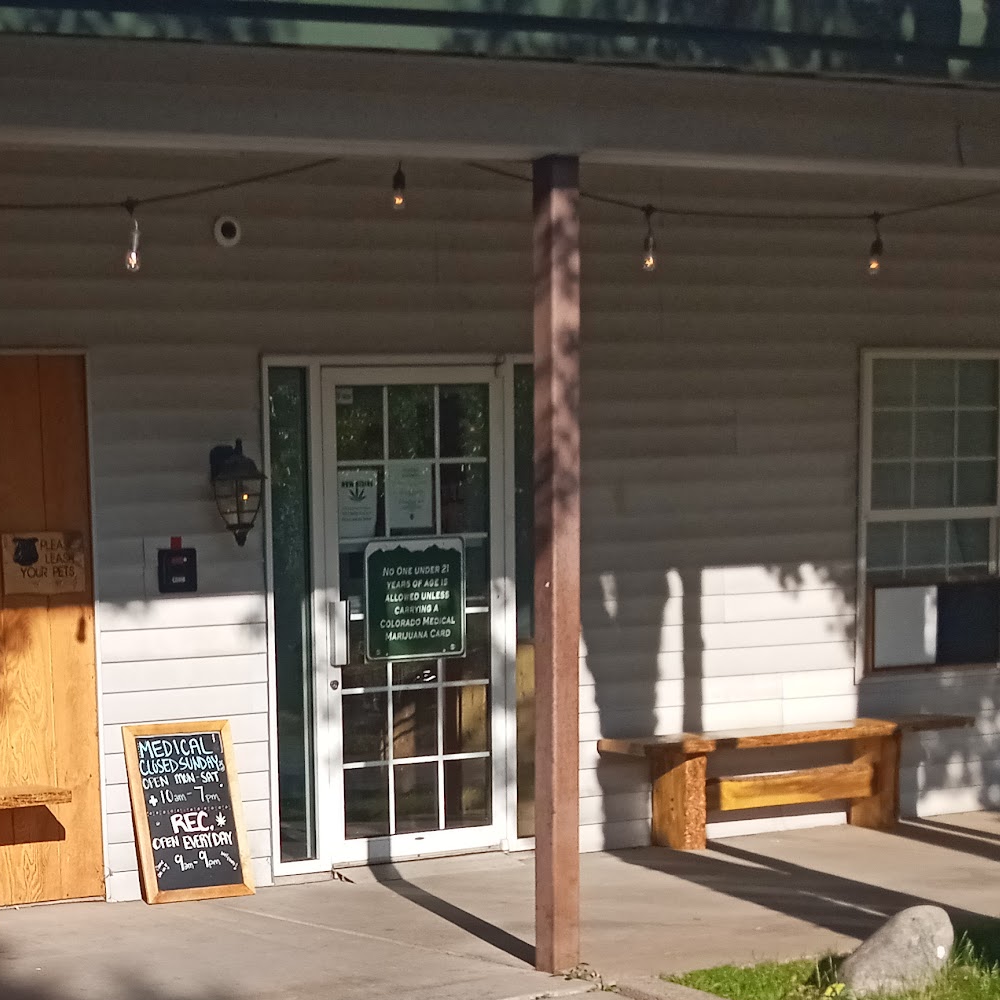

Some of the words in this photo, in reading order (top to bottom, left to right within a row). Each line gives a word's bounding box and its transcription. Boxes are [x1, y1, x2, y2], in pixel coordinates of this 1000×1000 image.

[20, 566, 48, 578] YOUR
[52, 566, 75, 578] PETS
[382, 568, 395, 576] NO
[396, 566, 413, 576] ONE
[414, 565, 440, 575] UNDER
[441, 564, 450, 573] 21
[386, 581, 411, 590] YEARS
[412, 580, 422, 588] OF
[423, 579, 440, 588] AGE
[440, 578, 448, 587] IS
[385, 593, 420, 602] ALLOWED
[421, 591, 450, 601] UNLESS
[394, 605, 432, 615] CARRYING
[433, 604, 439, 613] A
[380, 619, 421, 629] COLORADO
[422, 617, 456, 626] MEDICAL
[385, 632, 428, 641] MARIJUANA
[429, 630, 451, 638] CARD
[138, 737, 213, 758] MEDICAL
[139, 758, 179, 776] CLOSED
[179, 754, 219, 772] SUNDAY
[142, 775, 169, 790] OPEN
[170, 811, 215, 834] REC.
[152, 836, 179, 850] OPEN
